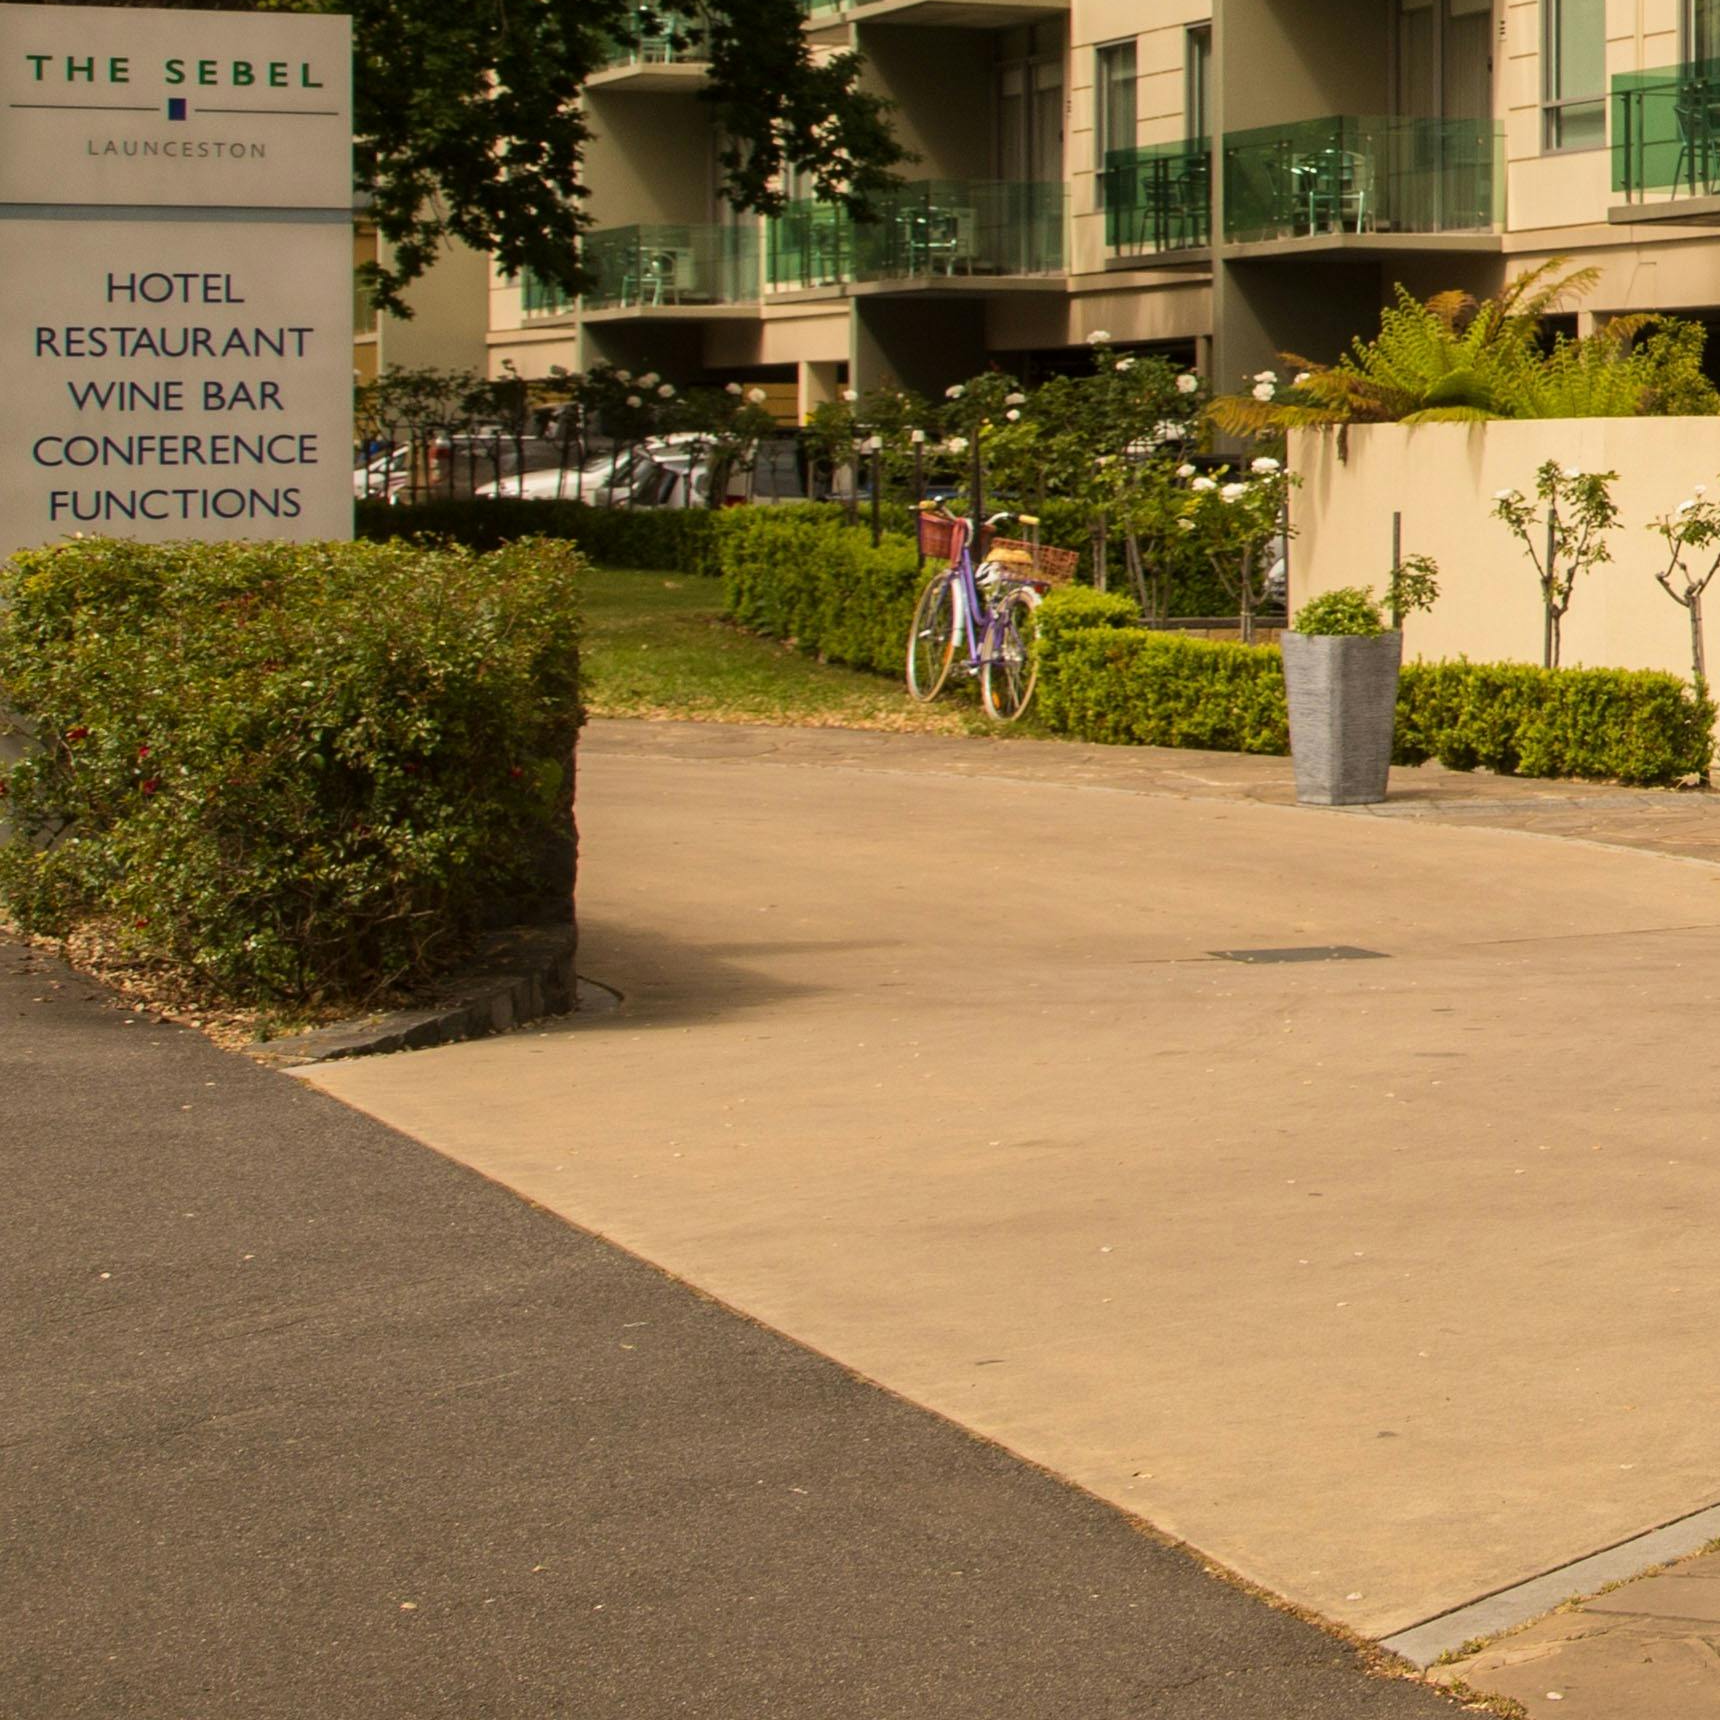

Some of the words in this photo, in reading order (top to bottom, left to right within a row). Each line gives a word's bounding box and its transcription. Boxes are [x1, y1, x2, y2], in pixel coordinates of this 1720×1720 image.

[25, 54, 131, 83] THE
[164, 58, 324, 89] SEBEL
[87, 138, 266, 160] LAUNCESTON
[106, 271, 245, 304] HOTEL
[35, 326, 315, 358] RESTAURANT
[67, 380, 184, 412] WINE
[202, 380, 285, 411] BAR
[32, 433, 319, 467] CONFERENCE
[50, 487, 301, 521] FUNCTIONS
